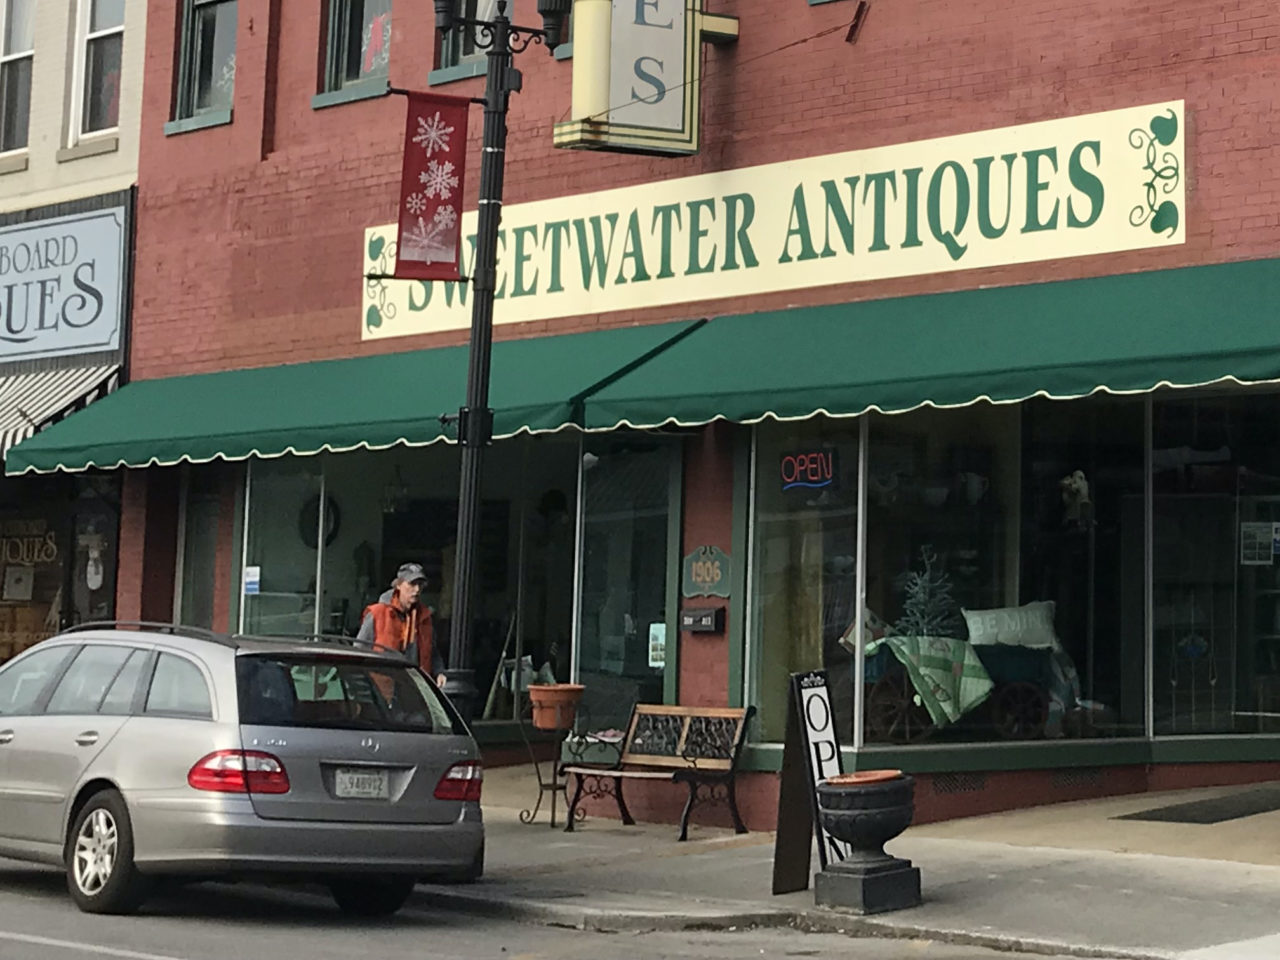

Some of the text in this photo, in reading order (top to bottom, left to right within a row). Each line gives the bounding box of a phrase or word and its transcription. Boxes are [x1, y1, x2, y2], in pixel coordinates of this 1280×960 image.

[778, 140, 1105, 261] ANTIQUES
[0, 234, 78, 275] BOARD
[0, 258, 103, 343] UES
[781, 452, 833, 482] OPEN
[692, 561, 721, 582] 1906
[806, 693, 851, 864] OPN
